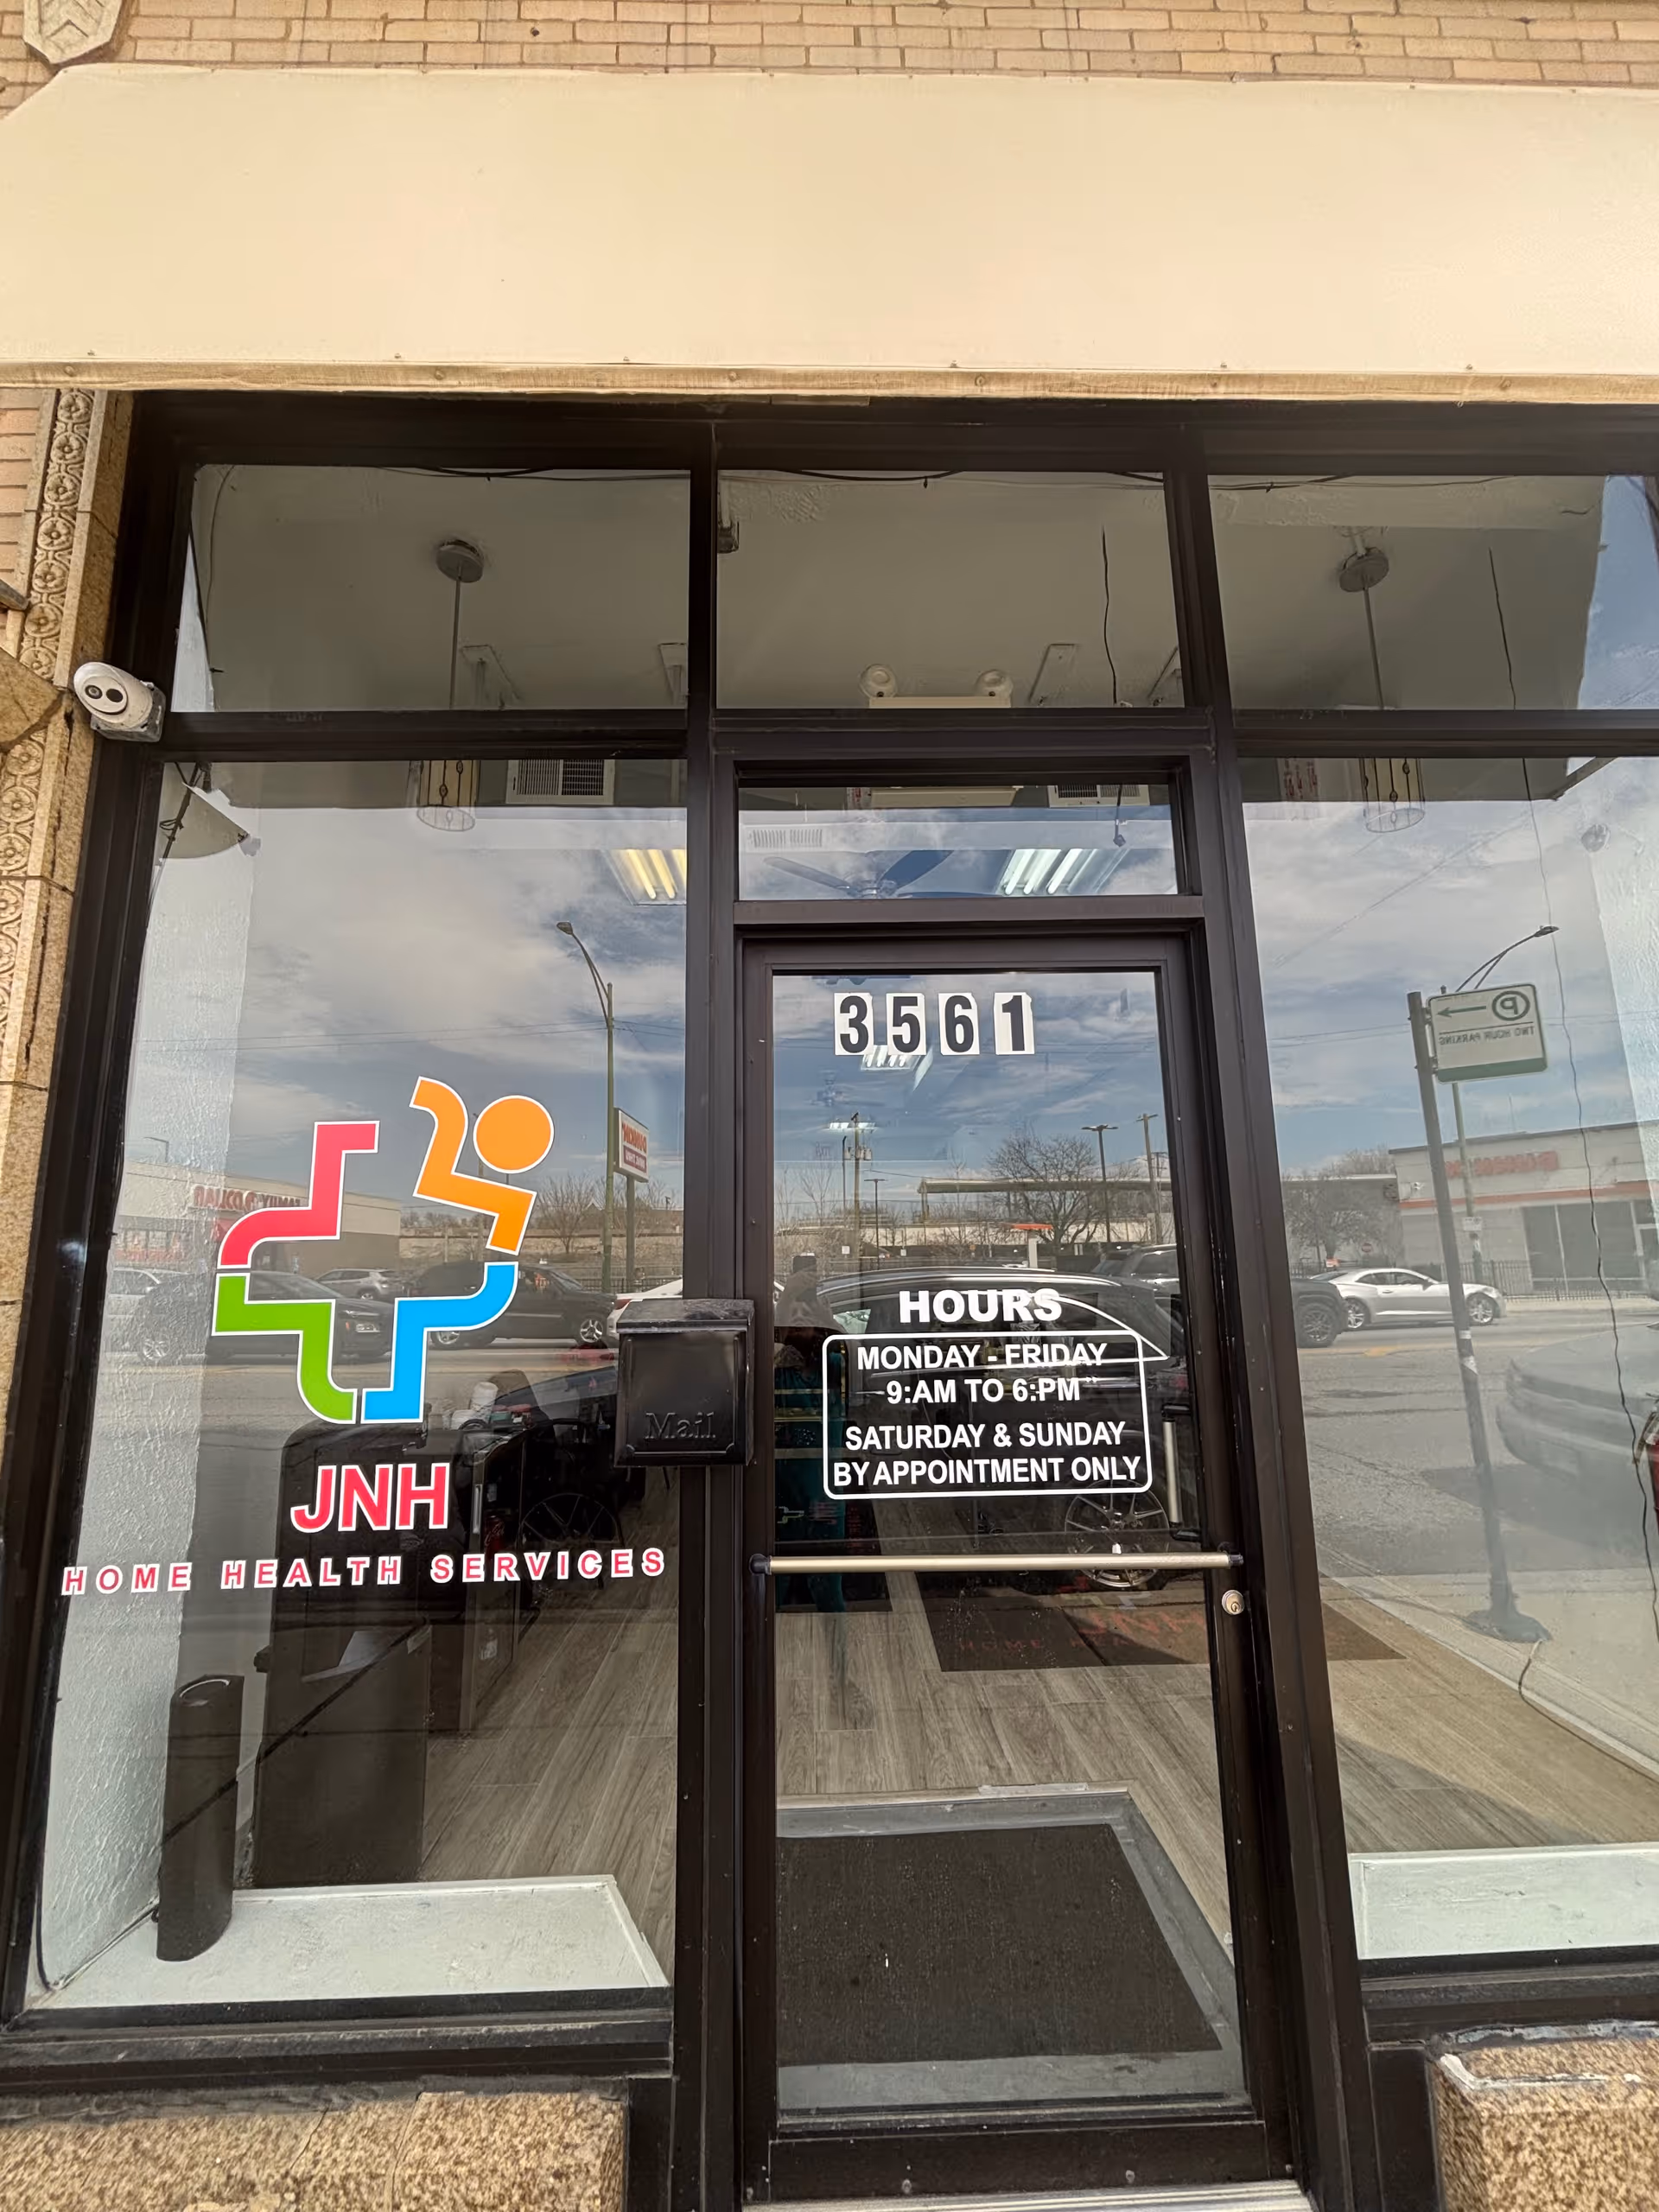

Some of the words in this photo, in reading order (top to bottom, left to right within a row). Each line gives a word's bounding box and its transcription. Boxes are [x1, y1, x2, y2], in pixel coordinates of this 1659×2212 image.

[839, 995, 1026, 1053] 3561
[899, 1288, 1062, 1324] HOURS
[857, 1344, 981, 1370] MONDAY
[1005, 1343, 1108, 1367] FRIDAY
[887, 1378, 957, 1404] 9:AM
[965, 1378, 1004, 1402] TO
[1012, 1377, 1080, 1402] 6:PM
[645, 1411, 716, 1439] Mail
[845, 1424, 986, 1451] SATURDAY
[993, 1422, 1013, 1448] &
[1019, 1421, 1126, 1447] SUNDAY
[834, 1461, 871, 1487] BY
[873, 1458, 1065, 1486] APPOINTMENT
[1071, 1455, 1141, 1482] ONLY
[290, 1463, 450, 1533] JNH
[61, 1562, 192, 1595] HOME
[220, 1556, 401, 1590] HEALTH
[430, 1548, 664, 1583] SERVICES
